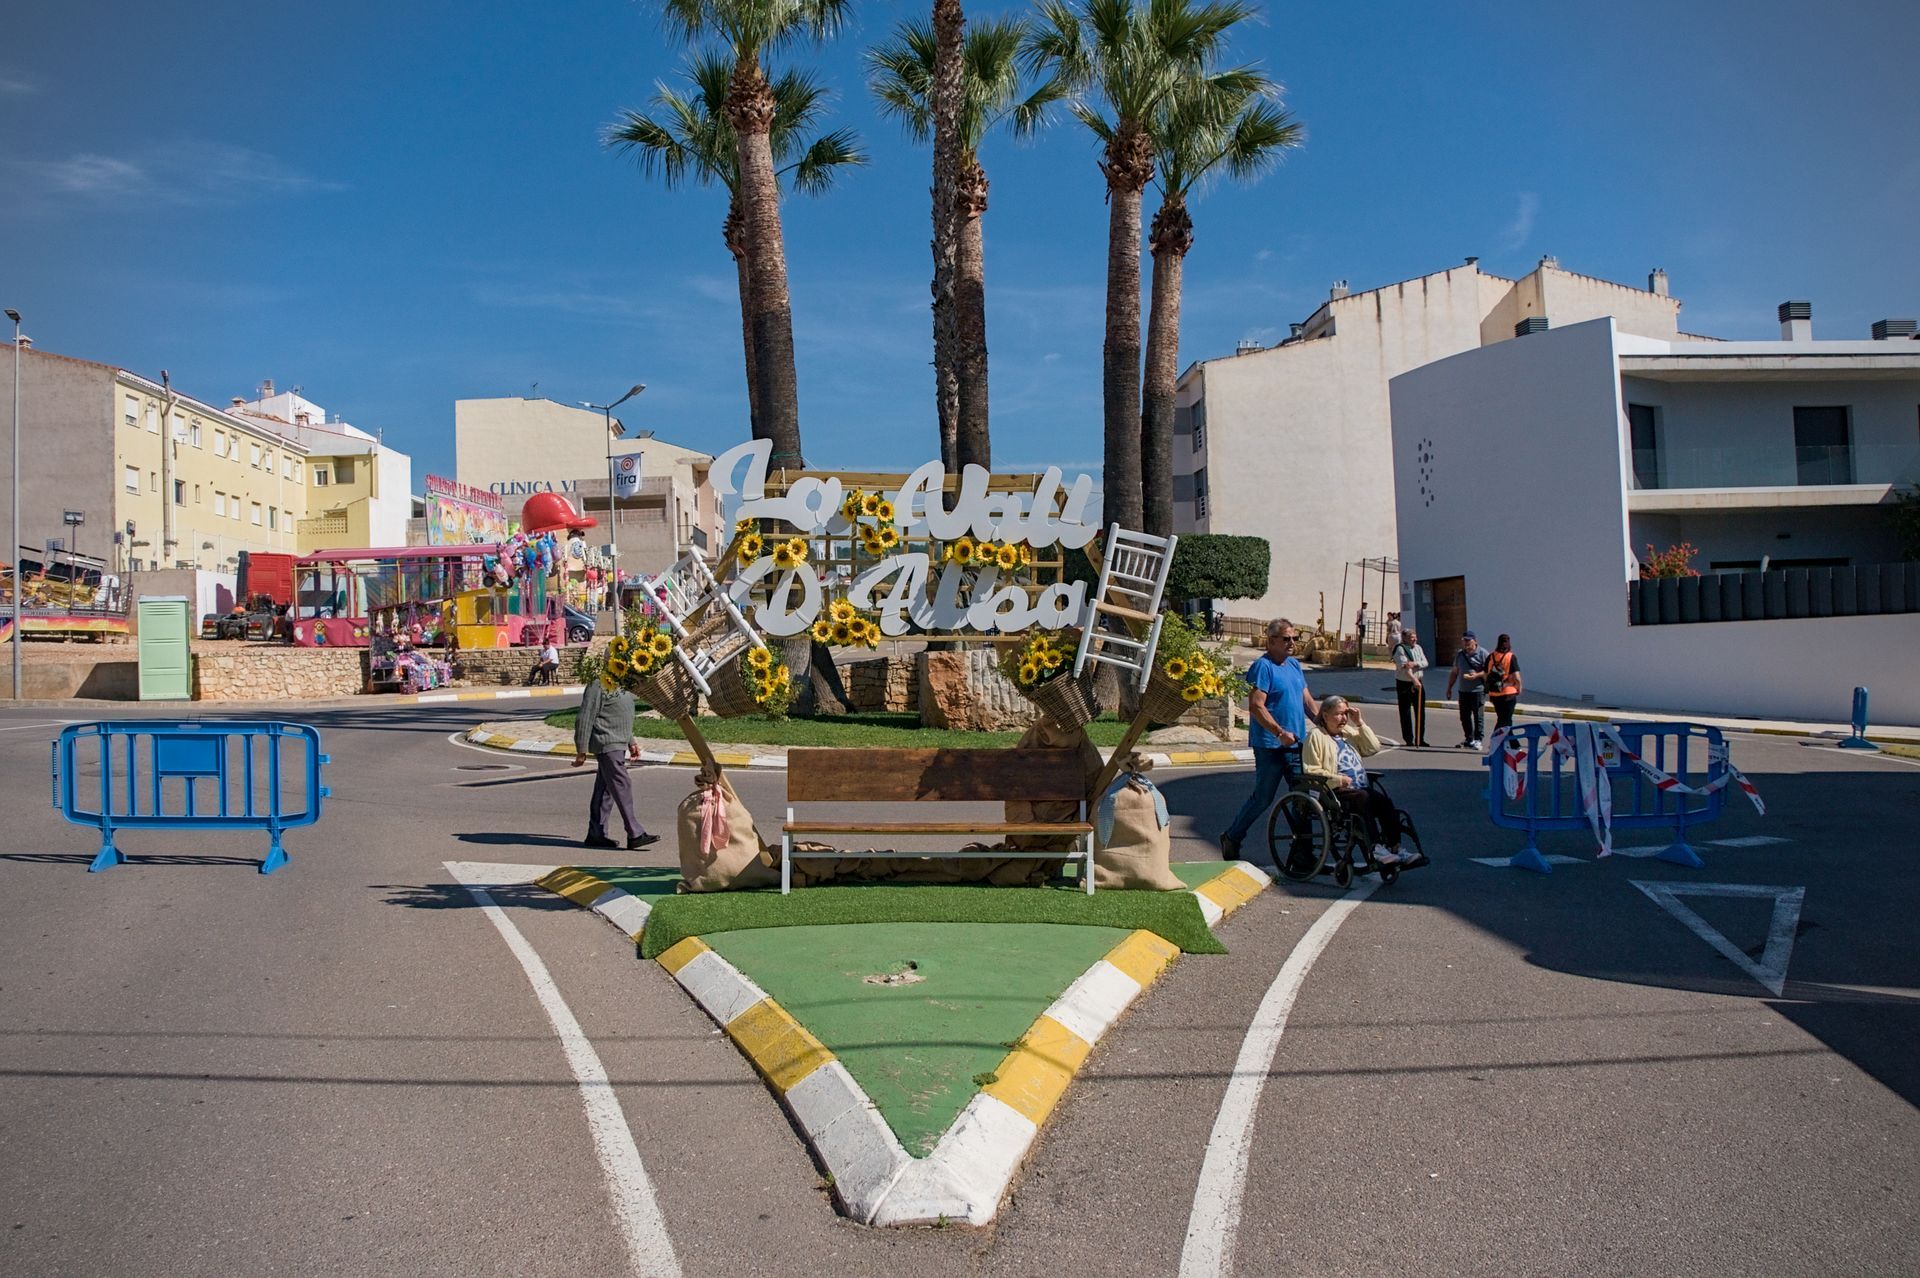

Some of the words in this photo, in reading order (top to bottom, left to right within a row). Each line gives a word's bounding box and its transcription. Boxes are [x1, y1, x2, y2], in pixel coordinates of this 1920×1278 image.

[490, 479, 553, 495] CLÍNICA
[616, 473, 637, 486] fira
[708, 438, 850, 533] La
[894, 459, 1099, 549] Vall
